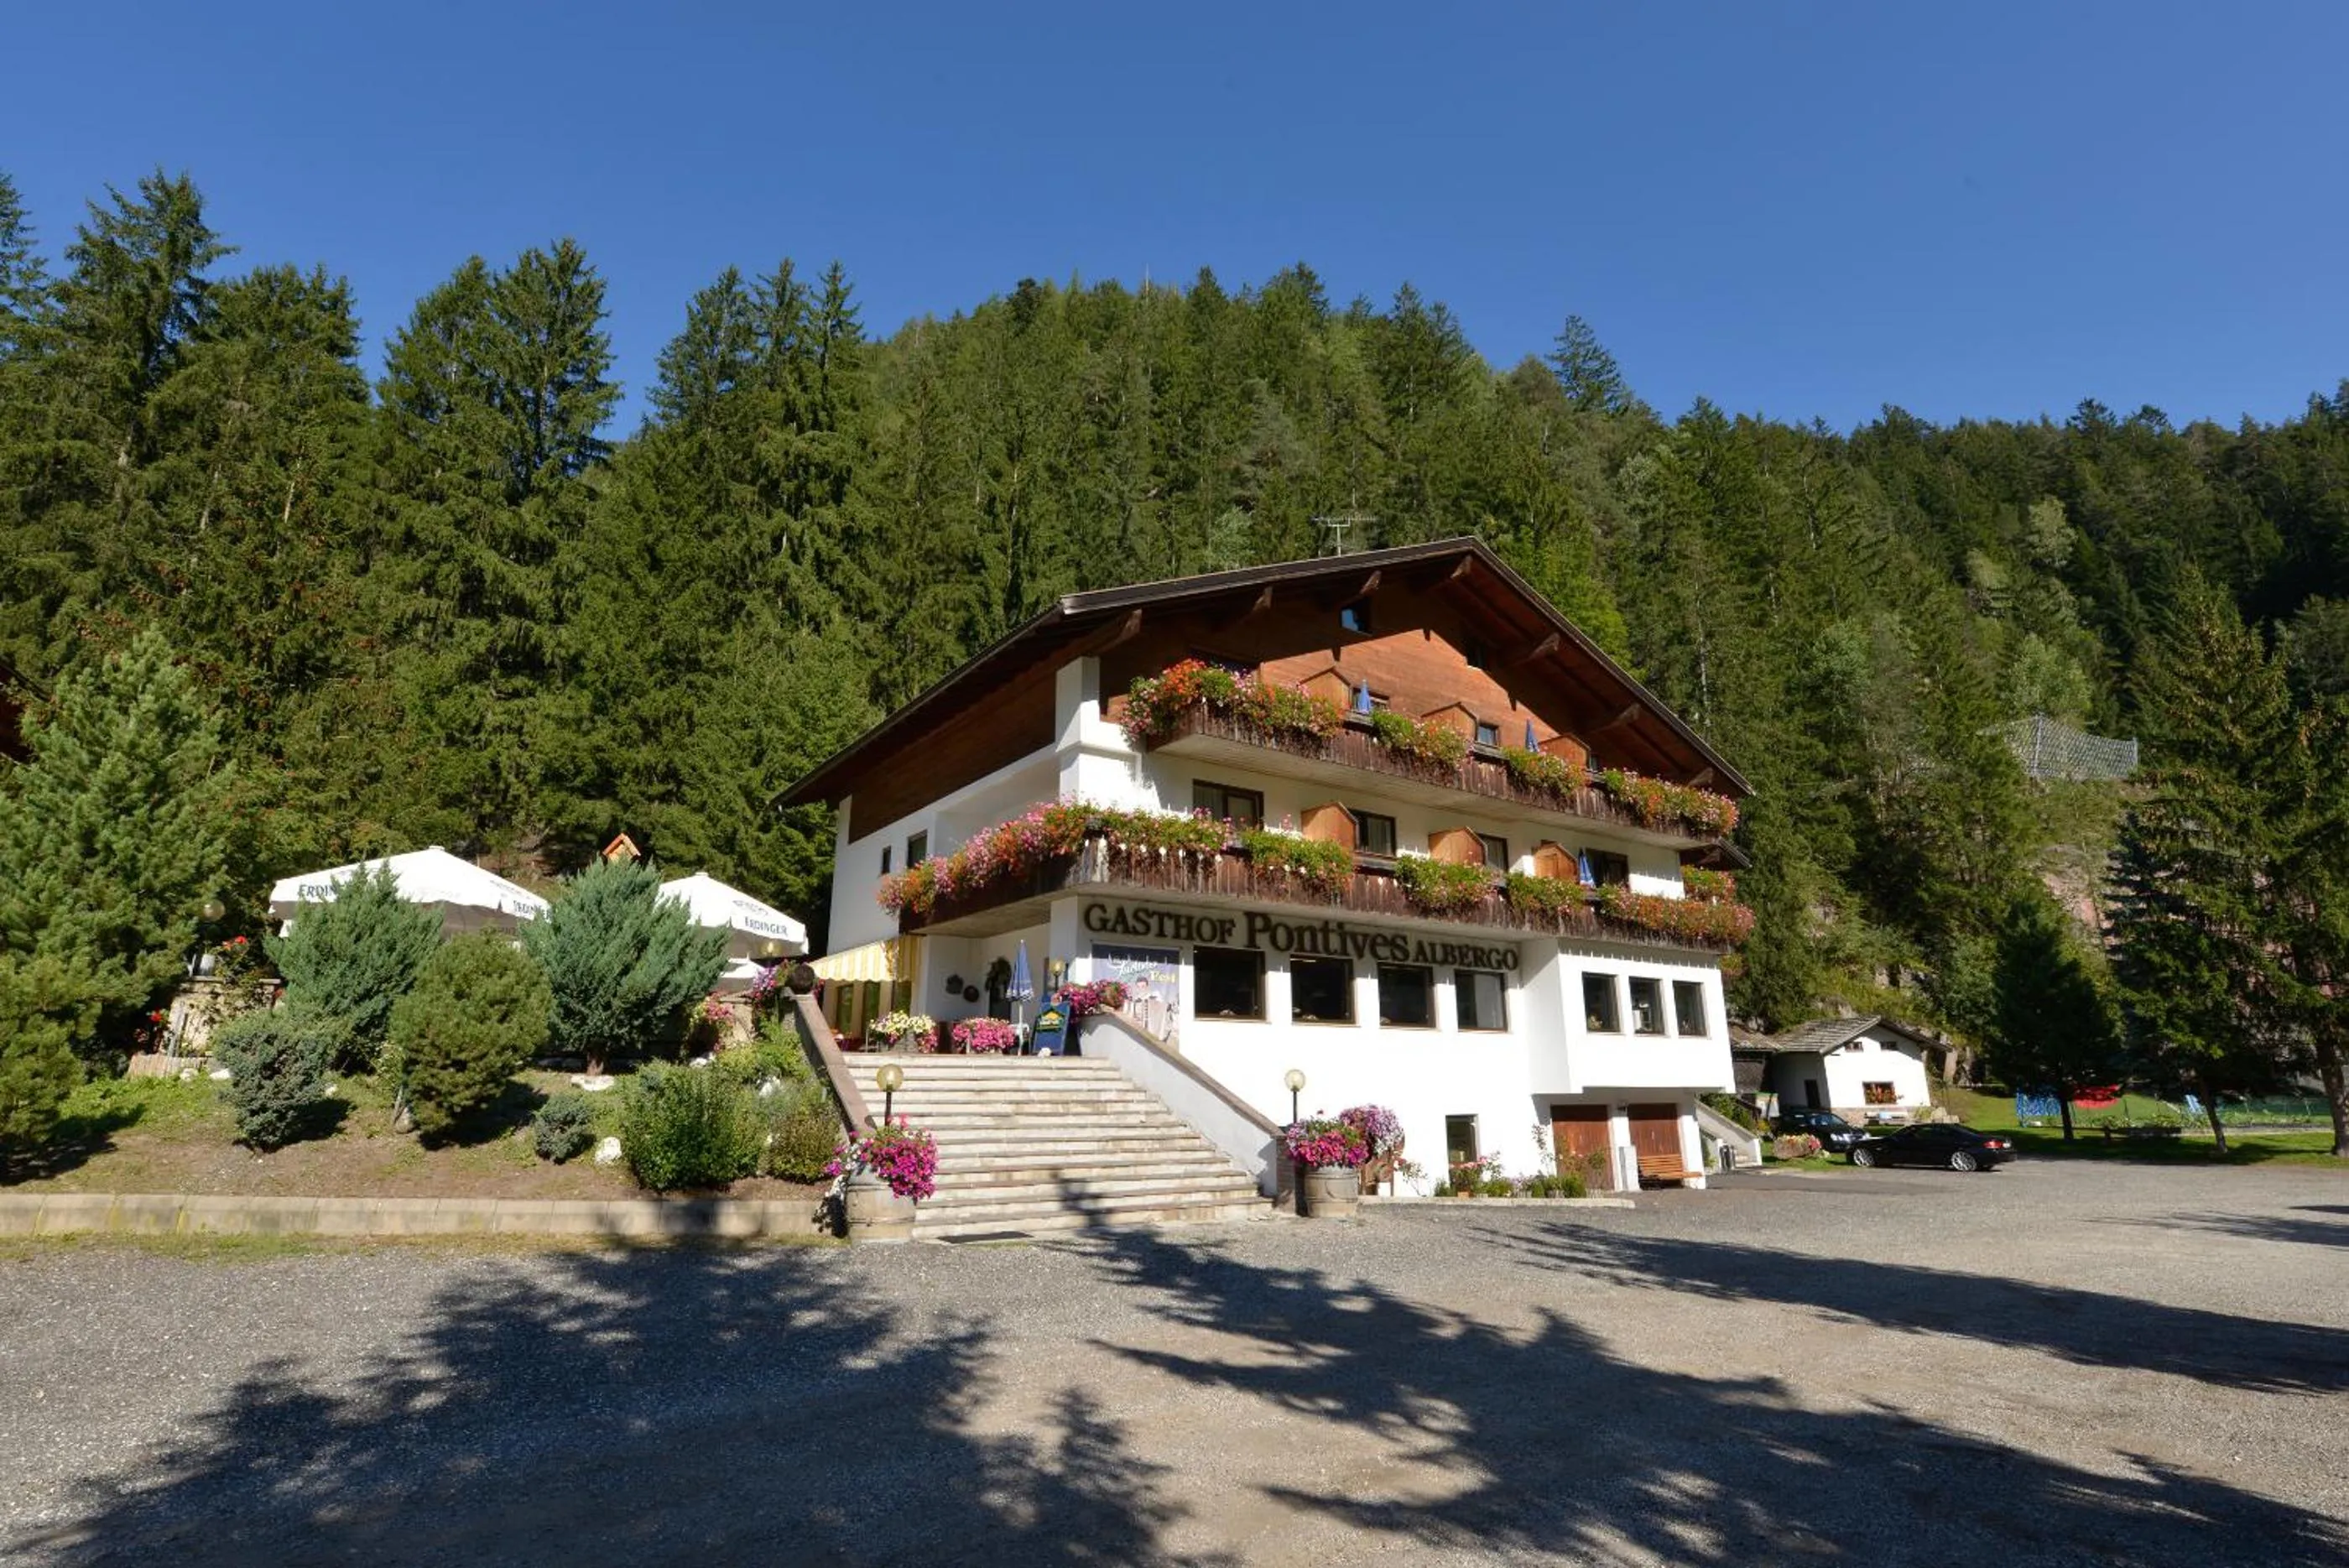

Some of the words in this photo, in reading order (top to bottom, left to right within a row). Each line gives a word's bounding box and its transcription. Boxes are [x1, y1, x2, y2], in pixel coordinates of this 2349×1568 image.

[744, 916, 789, 937] ERDINGER
[1083, 903, 1236, 944] GASTHOF
[1244, 911, 1410, 961] Pontives
[1413, 939, 1519, 972] ALBERGO
